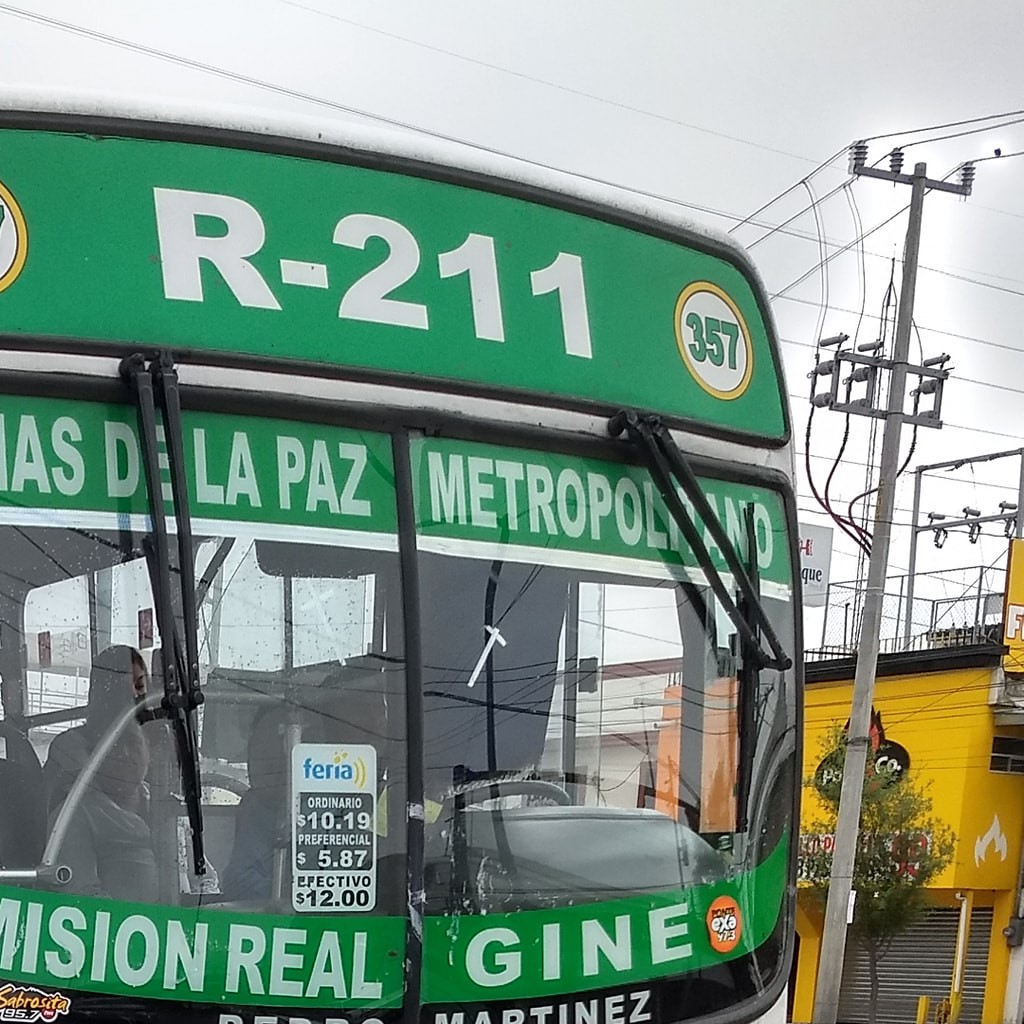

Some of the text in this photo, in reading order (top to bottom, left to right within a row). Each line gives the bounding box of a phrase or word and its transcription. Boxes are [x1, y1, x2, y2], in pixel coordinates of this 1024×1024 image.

[153, 187, 593, 359] R-211
[685, 312, 740, 371] 357
[193, 428, 262, 508] LA
[277, 435, 372, 517] PAZ
[303, 755, 354, 780] feria
[307, 797, 362, 809] ORDINARIO
[297, 811, 371, 830] $10.19
[298, 834, 371, 846] PREFERENCIAL
[318, 850, 368, 868] 5.87
[297, 876, 372, 888] EFECTIVO
[296, 890, 370, 907] $12.00
[465, 902, 693, 988] GINE
[225, 923, 383, 999] REAL
[4, 1008, 40, 1019] 95.7
